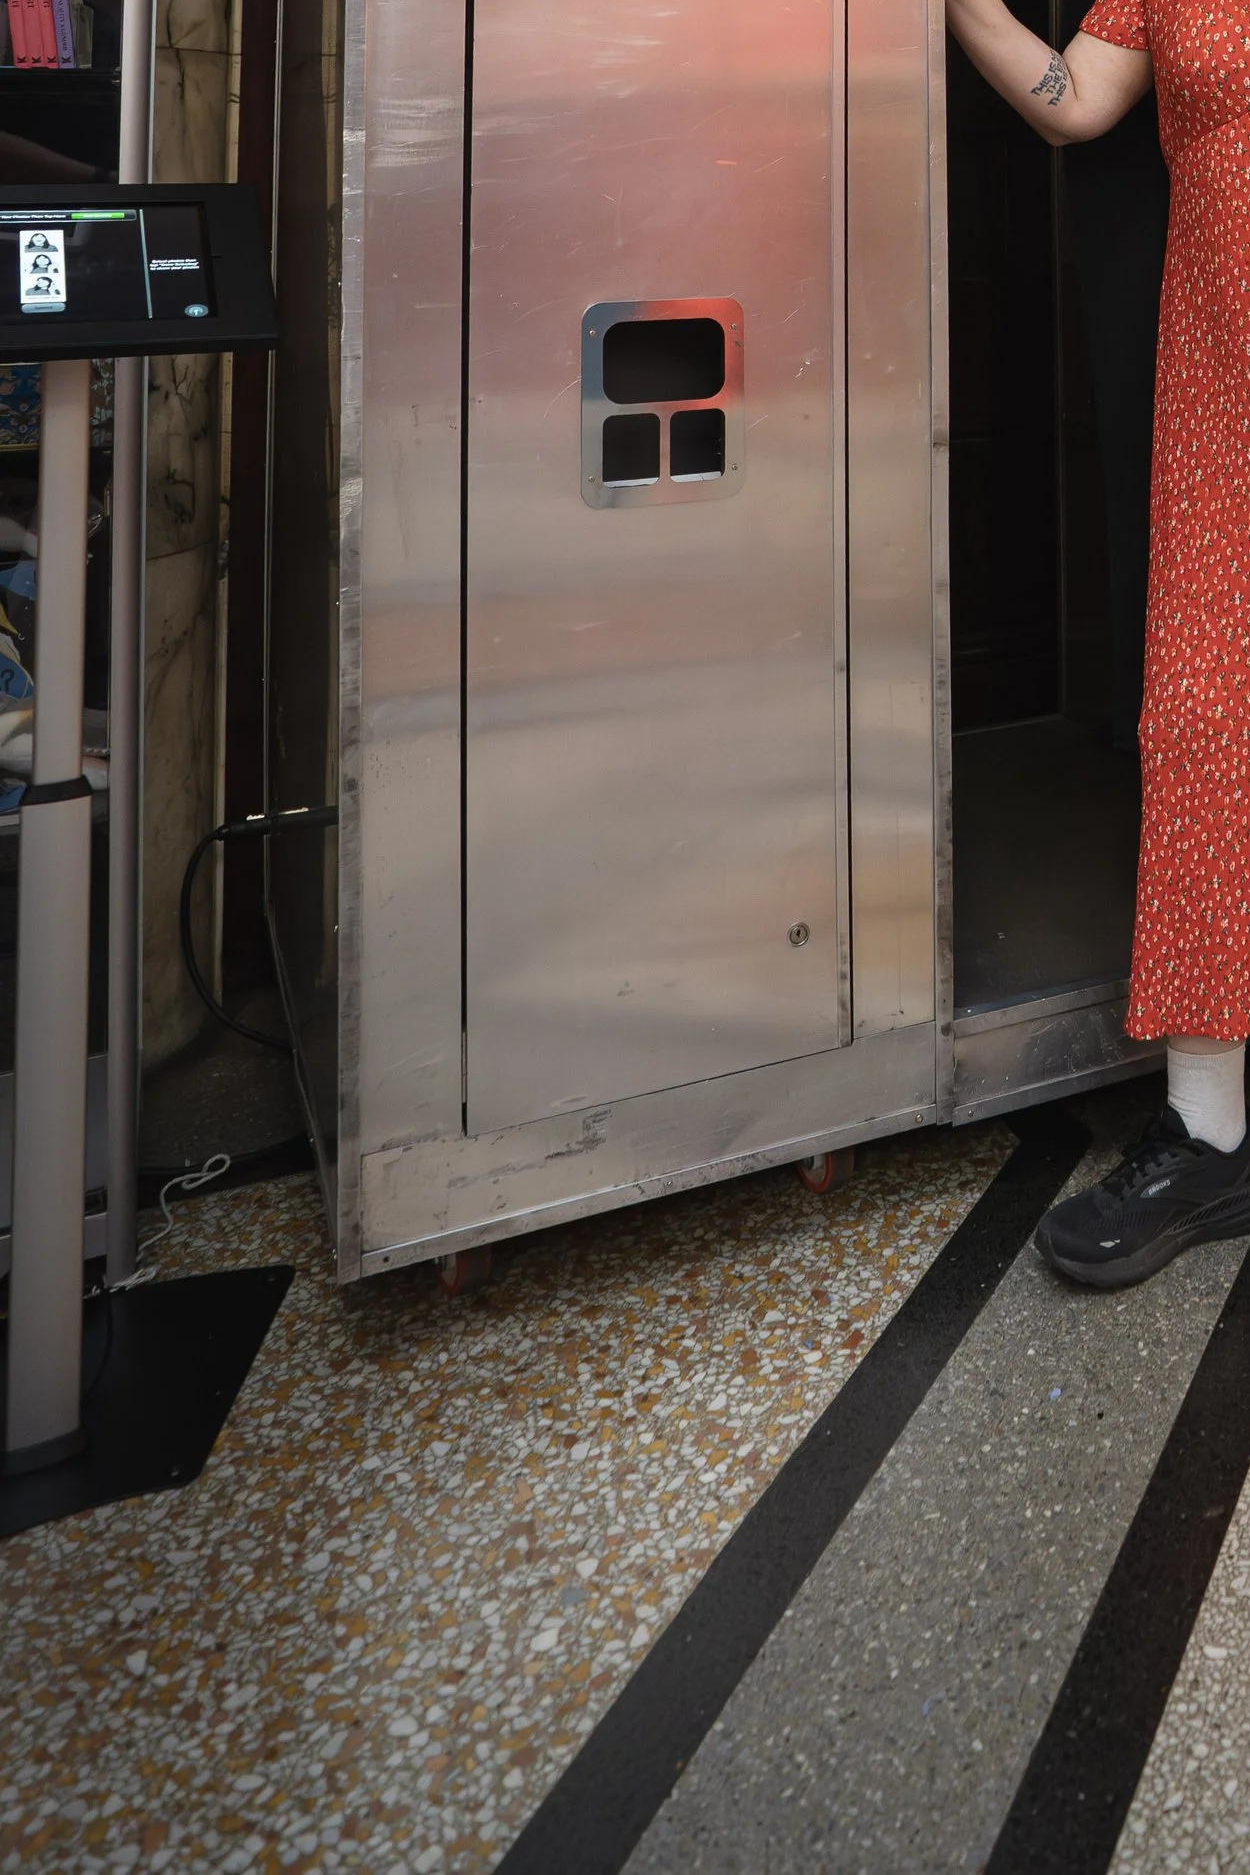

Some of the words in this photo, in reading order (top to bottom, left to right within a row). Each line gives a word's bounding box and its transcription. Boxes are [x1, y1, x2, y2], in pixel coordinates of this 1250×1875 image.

[1031, 74, 1053, 96] THIS
[1044, 73, 1062, 93] THE
[1048, 81, 1067, 106] THIS
